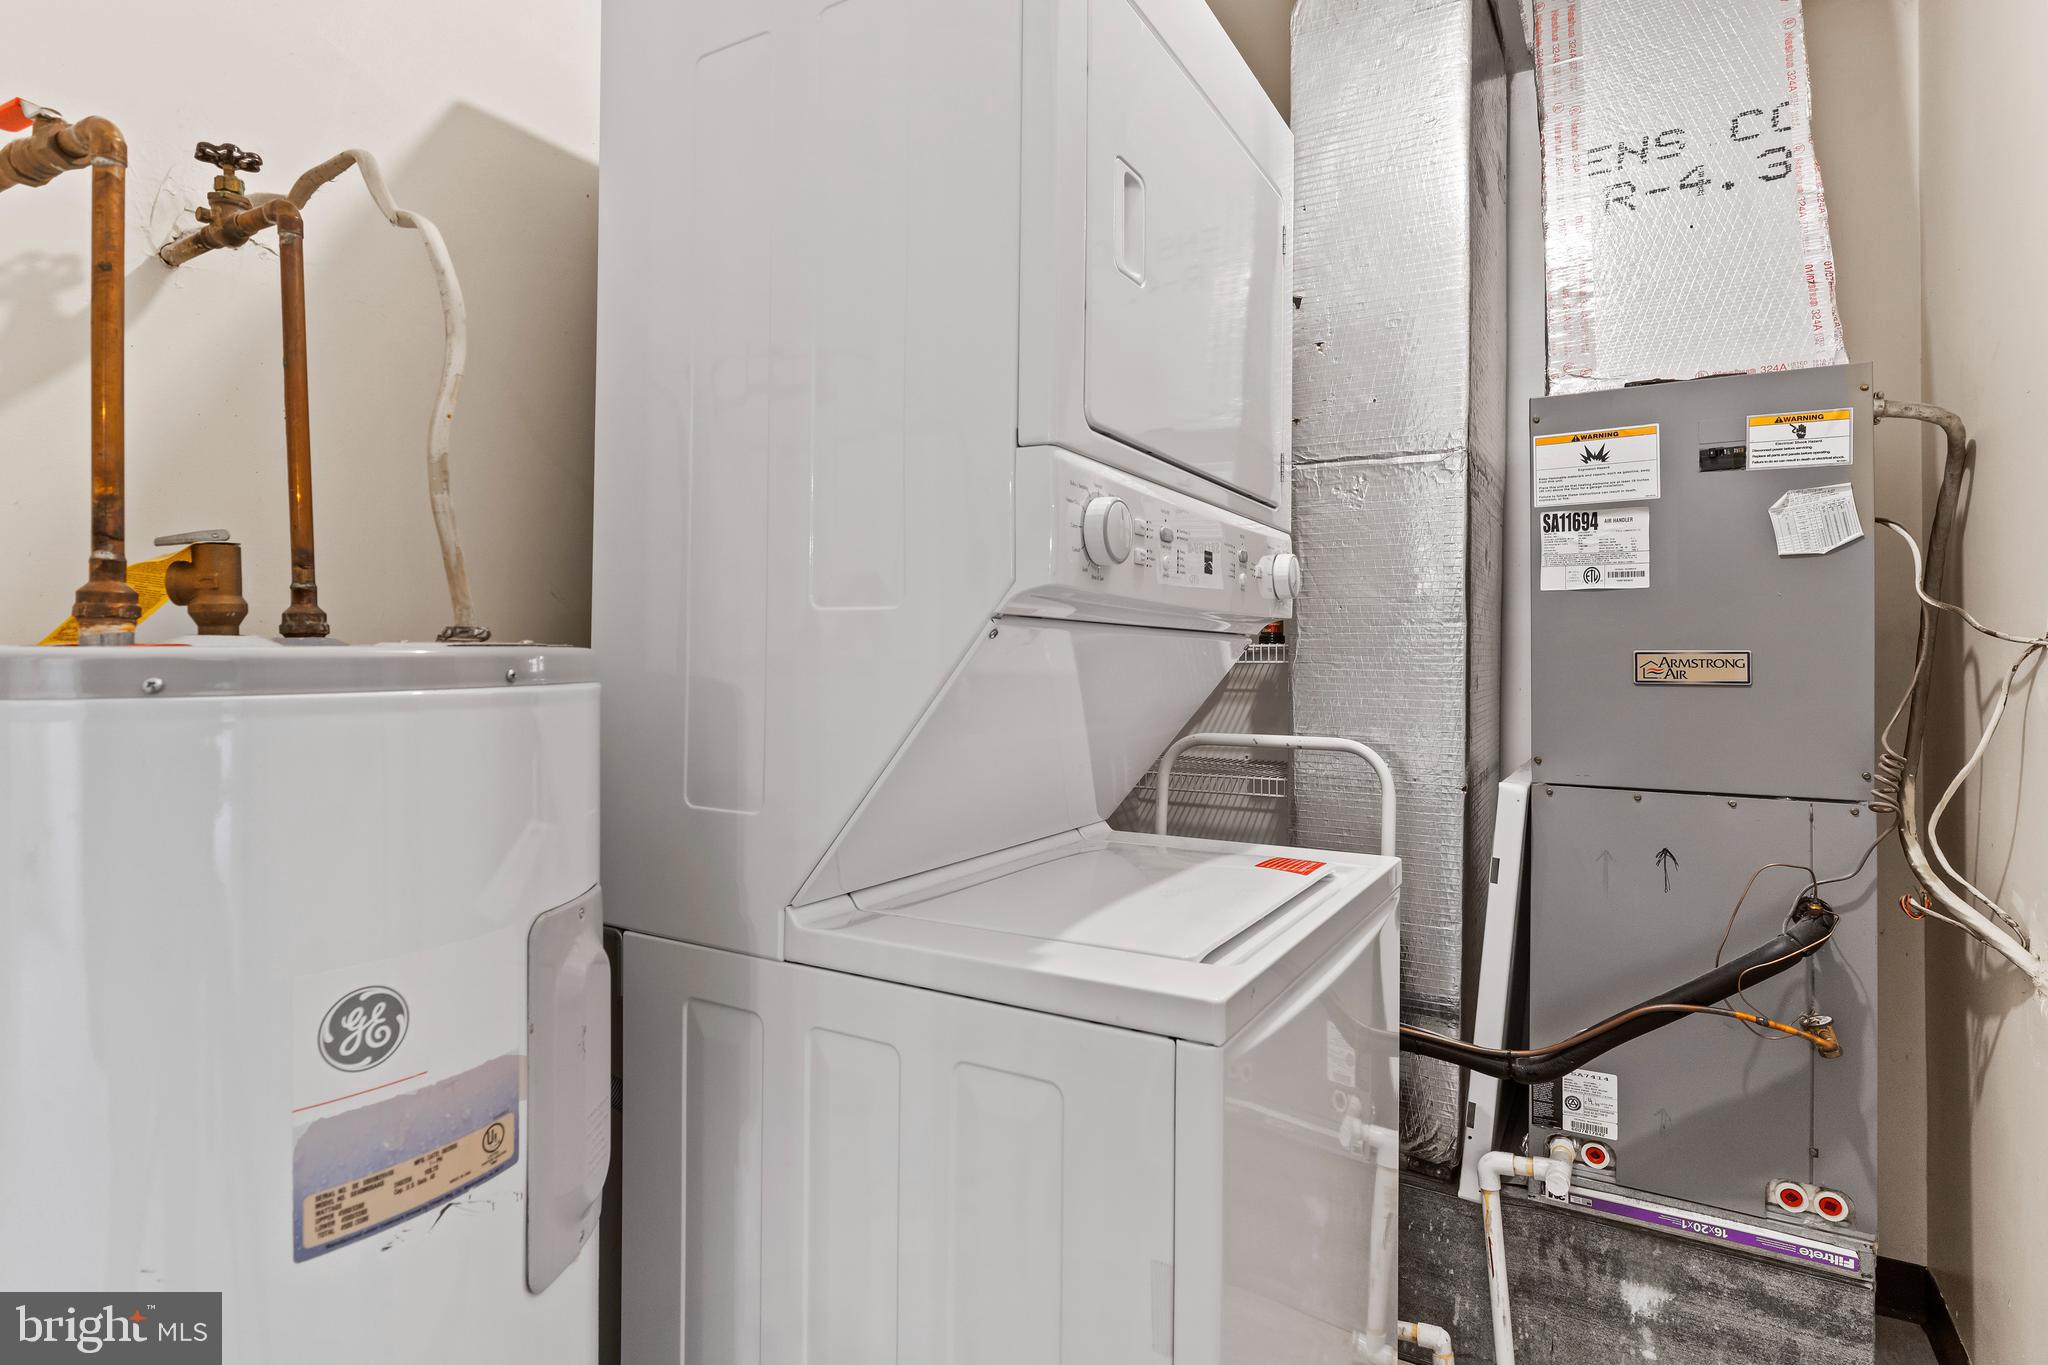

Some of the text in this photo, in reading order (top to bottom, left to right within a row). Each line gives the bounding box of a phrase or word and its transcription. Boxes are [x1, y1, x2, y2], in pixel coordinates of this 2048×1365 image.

[1552, 44, 1561, 63] 324A
[1568, 39, 1578, 58] 324A
[1787, 70, 1797, 92] 324A
[1811, 309, 1822, 331] 324A
[1760, 363, 1787, 374] 324A
[1783, 414, 1824, 422] WARNING
[1580, 431, 1619, 440] WARNING
[1543, 512, 1598, 533] SA11694
[1659, 657, 1745, 668] ARMSTRONG
[1681, 1219, 1728, 1239] 16x20x1
[1799, 1247, 1855, 1270] Filtrete
